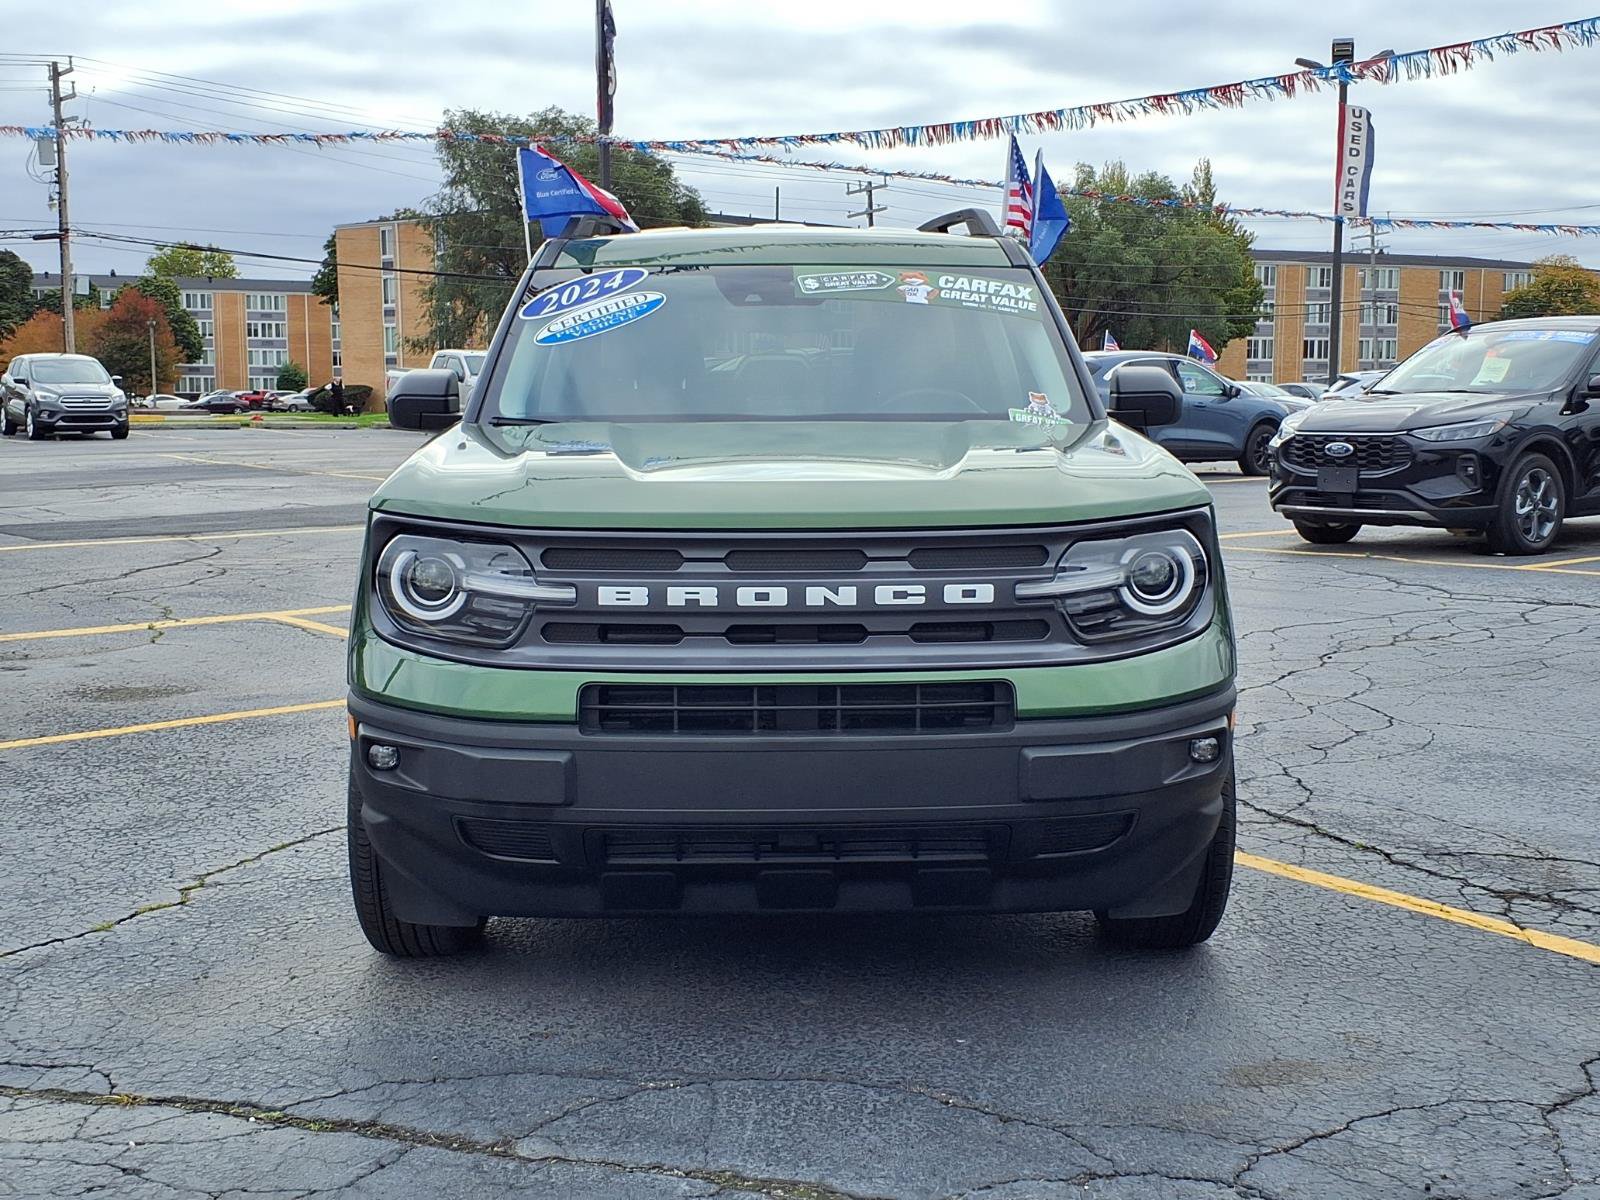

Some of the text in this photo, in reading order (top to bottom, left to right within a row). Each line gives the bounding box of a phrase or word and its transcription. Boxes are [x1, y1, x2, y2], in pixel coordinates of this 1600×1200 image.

[1343, 108, 1363, 212] USED CARS
[550, 189, 574, 197] Certified
[540, 271, 625, 315] 2024
[938, 275, 1034, 301] CARFAX
[547, 294, 648, 333] CERTIFIED
[939, 289, 991, 303] GREAT
[990, 296, 1038, 313] VALUE
[555, 304, 648, 338] PRE-OWNED
[571, 312, 638, 337] VEHICLE
[1015, 413, 1043, 424] GREAT
[598, 584, 995, 607] BRONCO
